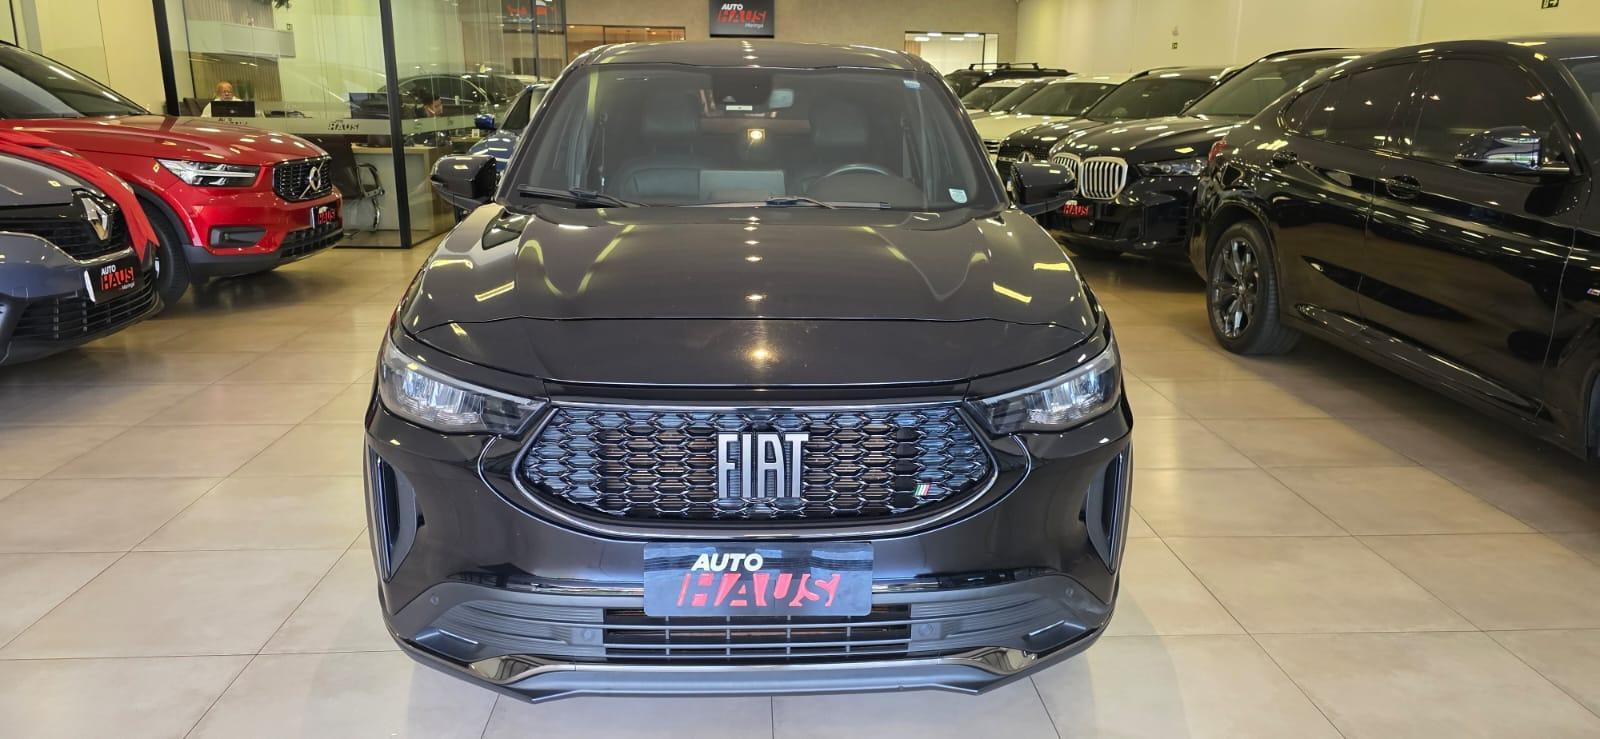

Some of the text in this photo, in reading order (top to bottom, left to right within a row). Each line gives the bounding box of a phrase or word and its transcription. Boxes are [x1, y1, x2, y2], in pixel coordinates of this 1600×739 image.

[721, 3, 744, 11] AUTO
[101, 264, 117, 276] AUTO
[101, 266, 135, 291] HAUS
[718, 432, 809, 498] FIAT
[691, 553, 764, 572] AUTO
[676, 573, 841, 607] HAUS
